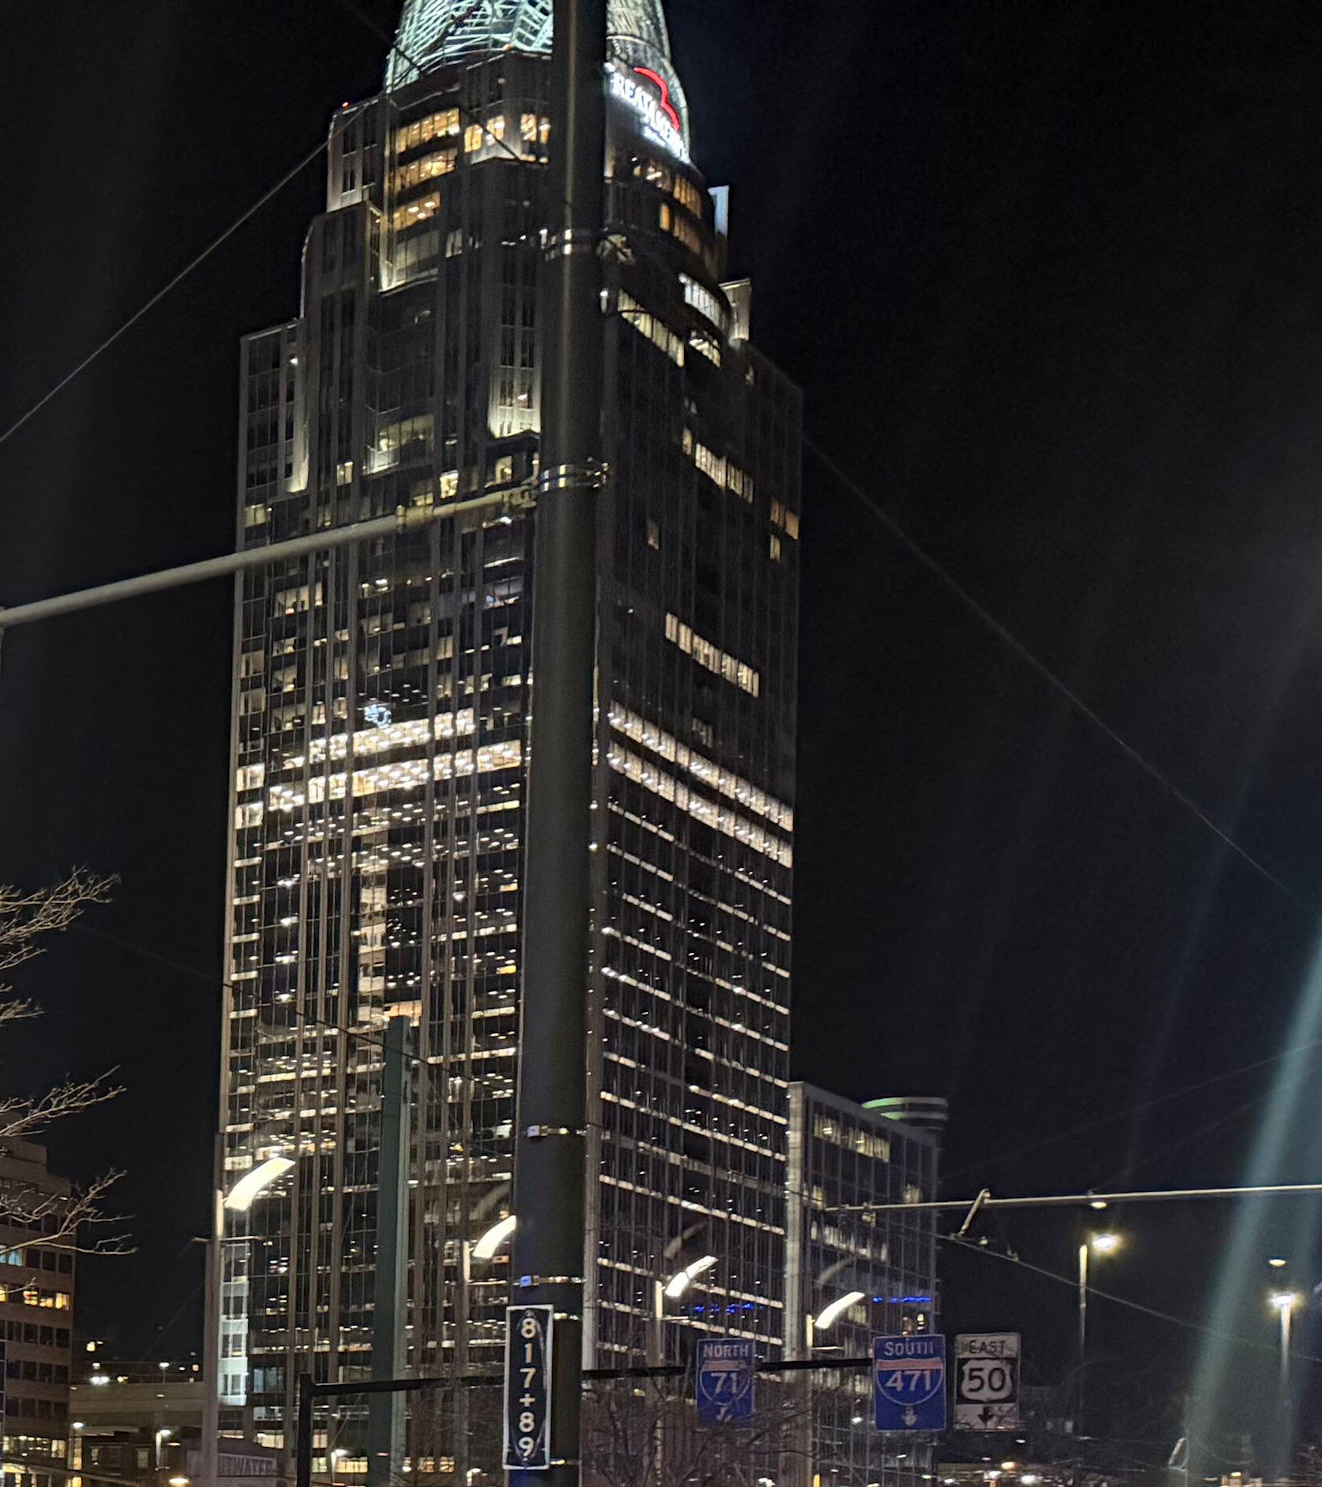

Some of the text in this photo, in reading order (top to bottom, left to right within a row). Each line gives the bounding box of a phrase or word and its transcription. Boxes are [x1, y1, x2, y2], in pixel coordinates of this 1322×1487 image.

[703, 1344, 749, 1358] NORTH
[884, 1340, 934, 1356] SOUTH
[968, 1339, 1008, 1355] EAST
[711, 1372, 738, 1394] 71
[885, 1371, 932, 1393] 471
[967, 1367, 1006, 1393] 50
